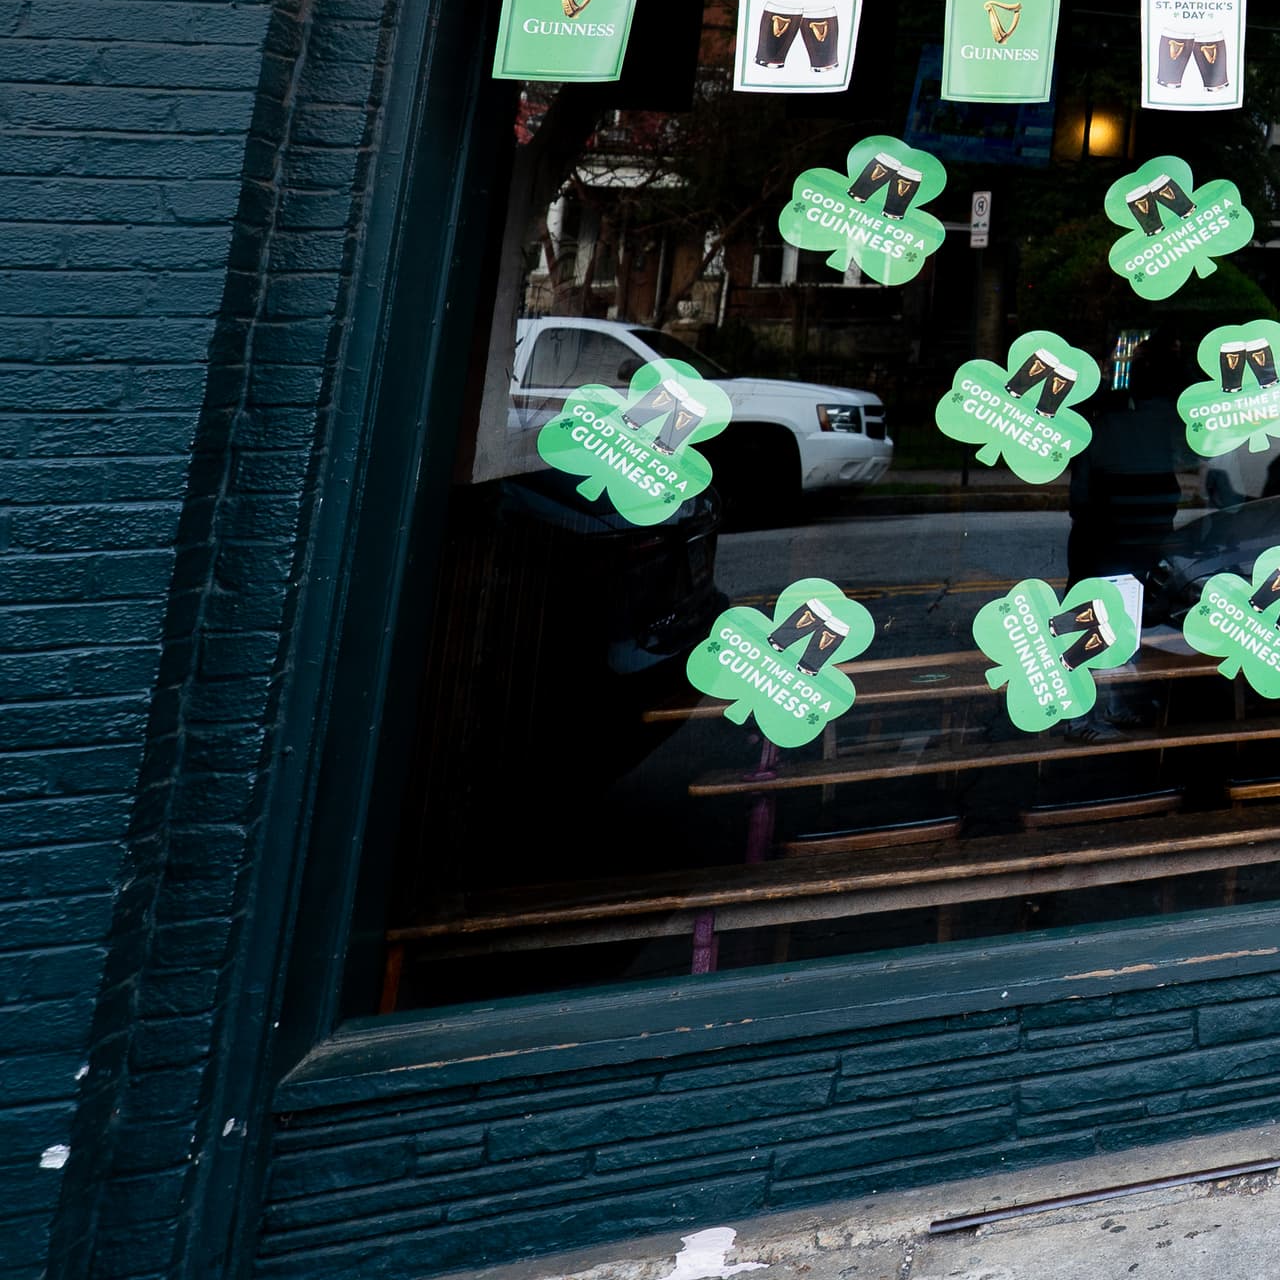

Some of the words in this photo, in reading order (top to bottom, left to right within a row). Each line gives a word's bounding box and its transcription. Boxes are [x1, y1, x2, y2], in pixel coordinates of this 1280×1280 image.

[523, 19, 615, 37] GUINNESS
[1175, 2, 1232, 10] PATRICK'S
[961, 45, 1038, 61] GUINNESS
[801, 188, 845, 214] GOOD
[849, 208, 883, 230] TIME
[884, 224, 914, 244] FOR
[914, 240, 925, 250] A
[807, 207, 906, 258] GUINNESS
[1125, 243, 1163, 271] GOOD
[1163, 222, 1195, 245] TIME
[1194, 204, 1223, 225] FOR
[1224, 198, 1234, 208] A
[1145, 215, 1230, 275] GUINNESS
[961, 379, 1001, 407] GOOD
[1003, 402, 1034, 427] TIME
[1034, 422, 1062, 444] FOR
[1061, 440, 1071, 450] A
[963, 399, 1052, 456] GUINNESS
[1190, 402, 1231, 417] GOOD
[1234, 393, 1268, 408] TIME
[571, 426, 665, 496] GUINNESS
[572, 404, 615, 438] GOOD
[615, 433, 650, 462] TIME
[648, 458, 678, 484] FOR
[675, 481, 688, 492] A
[1208, 592, 1244, 621] GOOD
[1245, 617, 1274, 642] TIME
[718, 650, 810, 718] GUINNESS
[720, 627, 761, 660] GOOD
[761, 656, 794, 684] TIME
[793, 679, 822, 705] FOR
[819, 702, 832, 713] A
[1003, 615, 1053, 705] GUINNESS
[1014, 595, 1038, 634] GOOD
[1034, 635, 1055, 669] TIME
[1049, 668, 1068, 699] FOR
[1060, 701, 1072, 711] A
